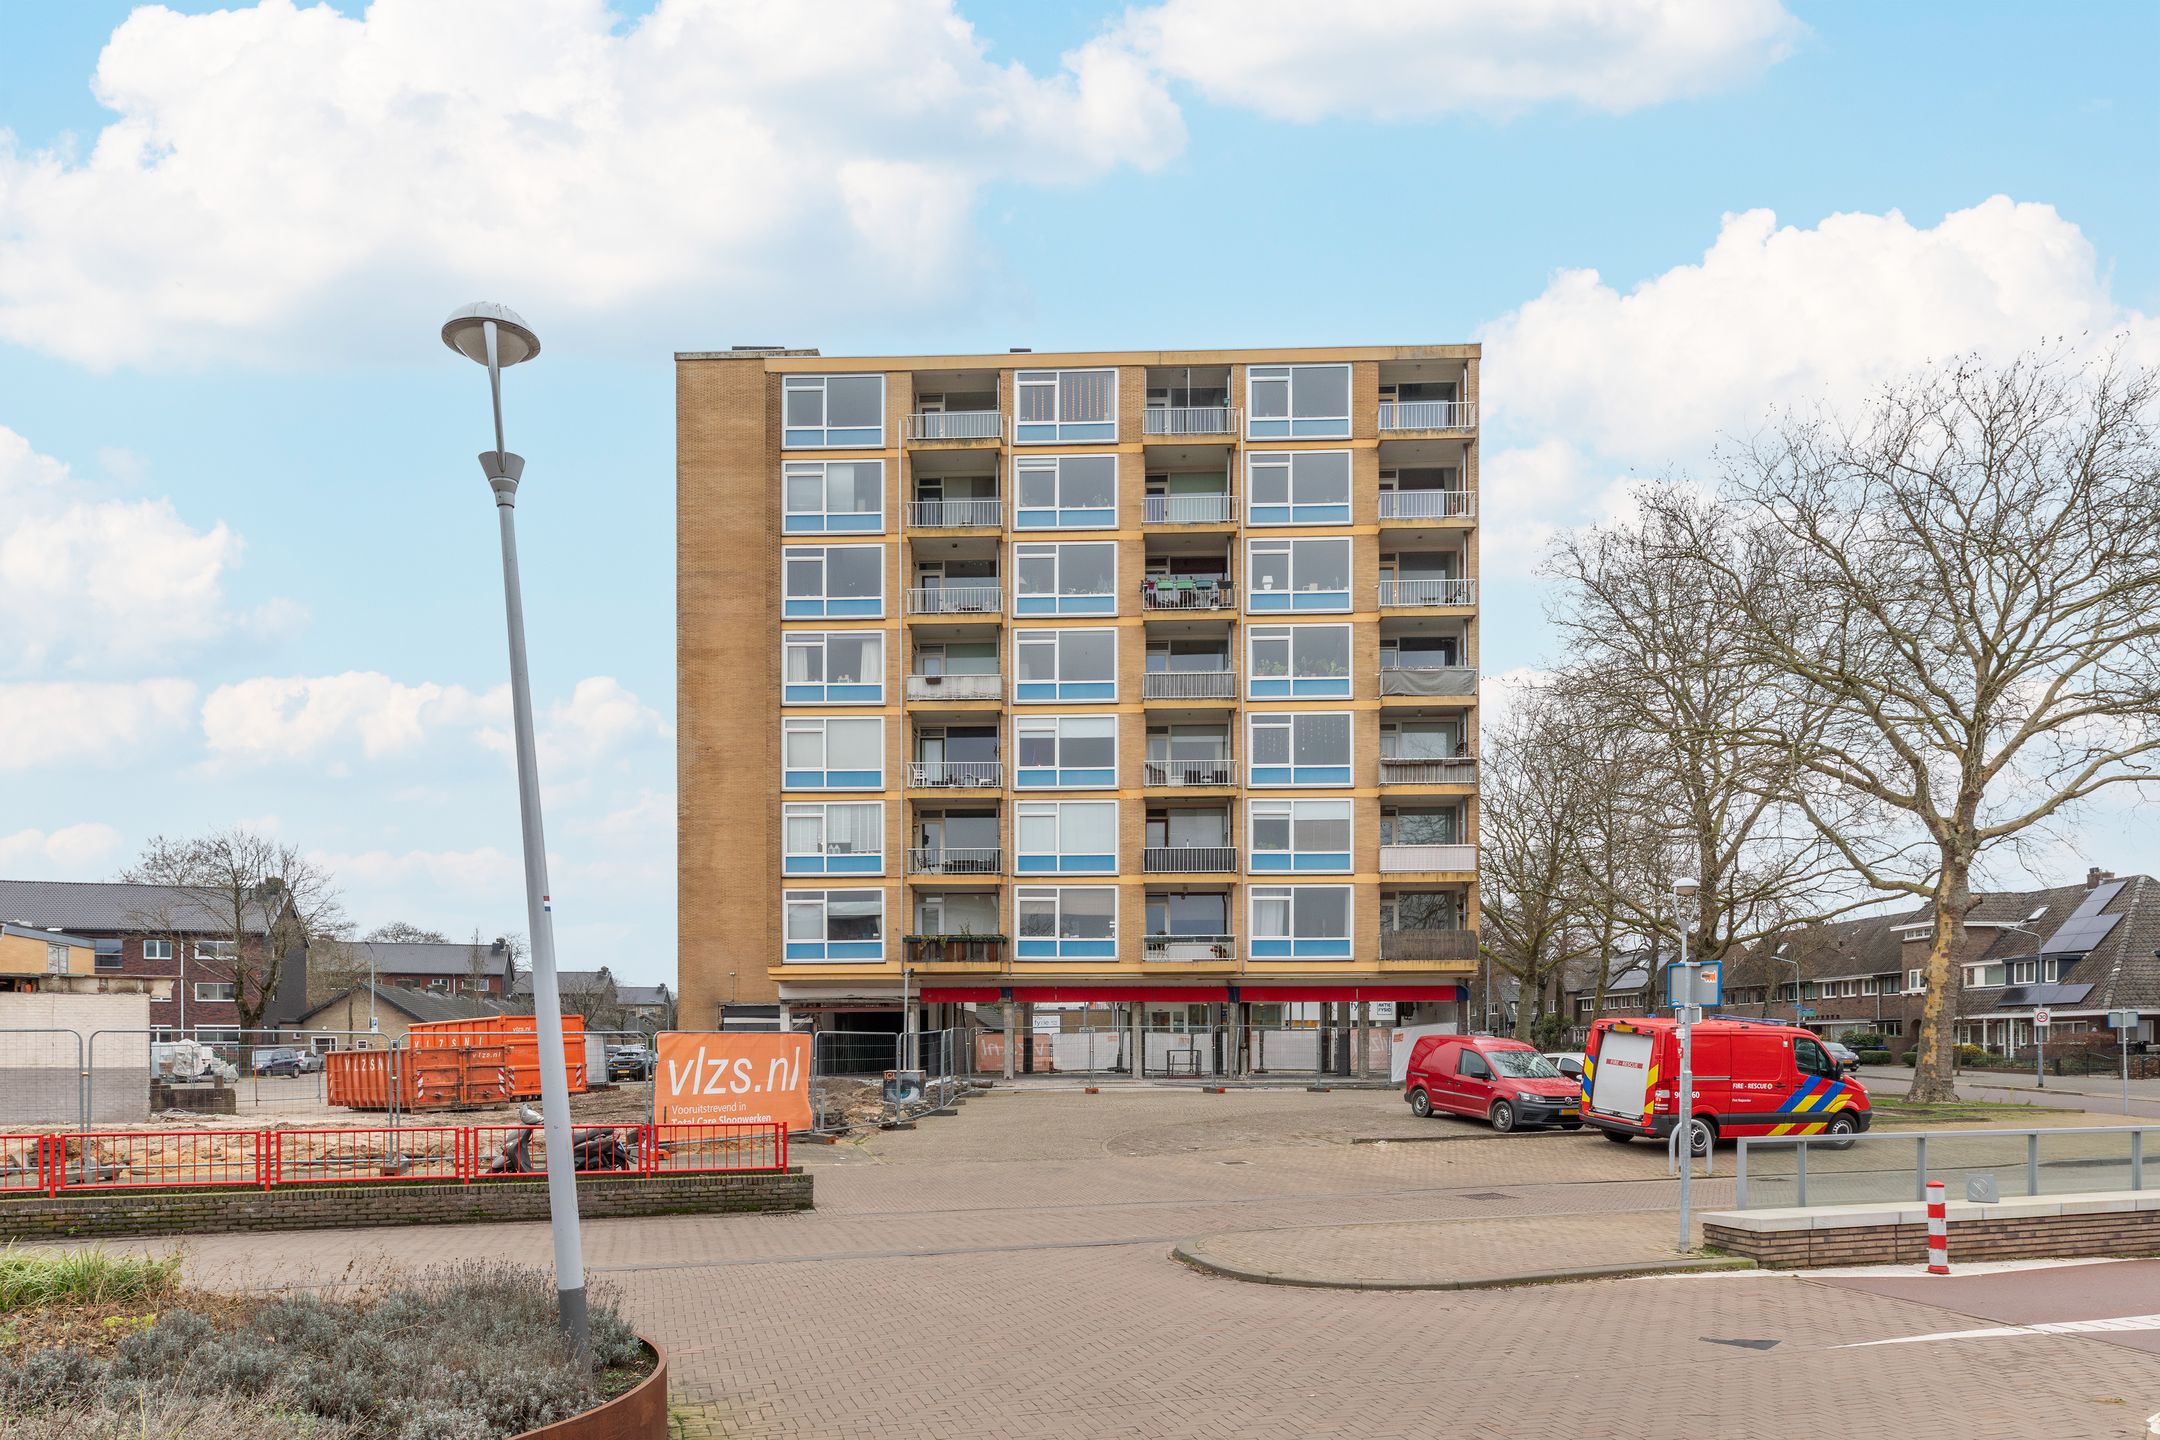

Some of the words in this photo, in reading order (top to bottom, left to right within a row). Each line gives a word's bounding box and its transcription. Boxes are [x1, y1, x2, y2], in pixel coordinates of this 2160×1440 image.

[668, 1046, 801, 1096] vlzs.nl
[671, 1102, 737, 1115] Vooruitstrevend
[739, 1102, 747, 1111] in
